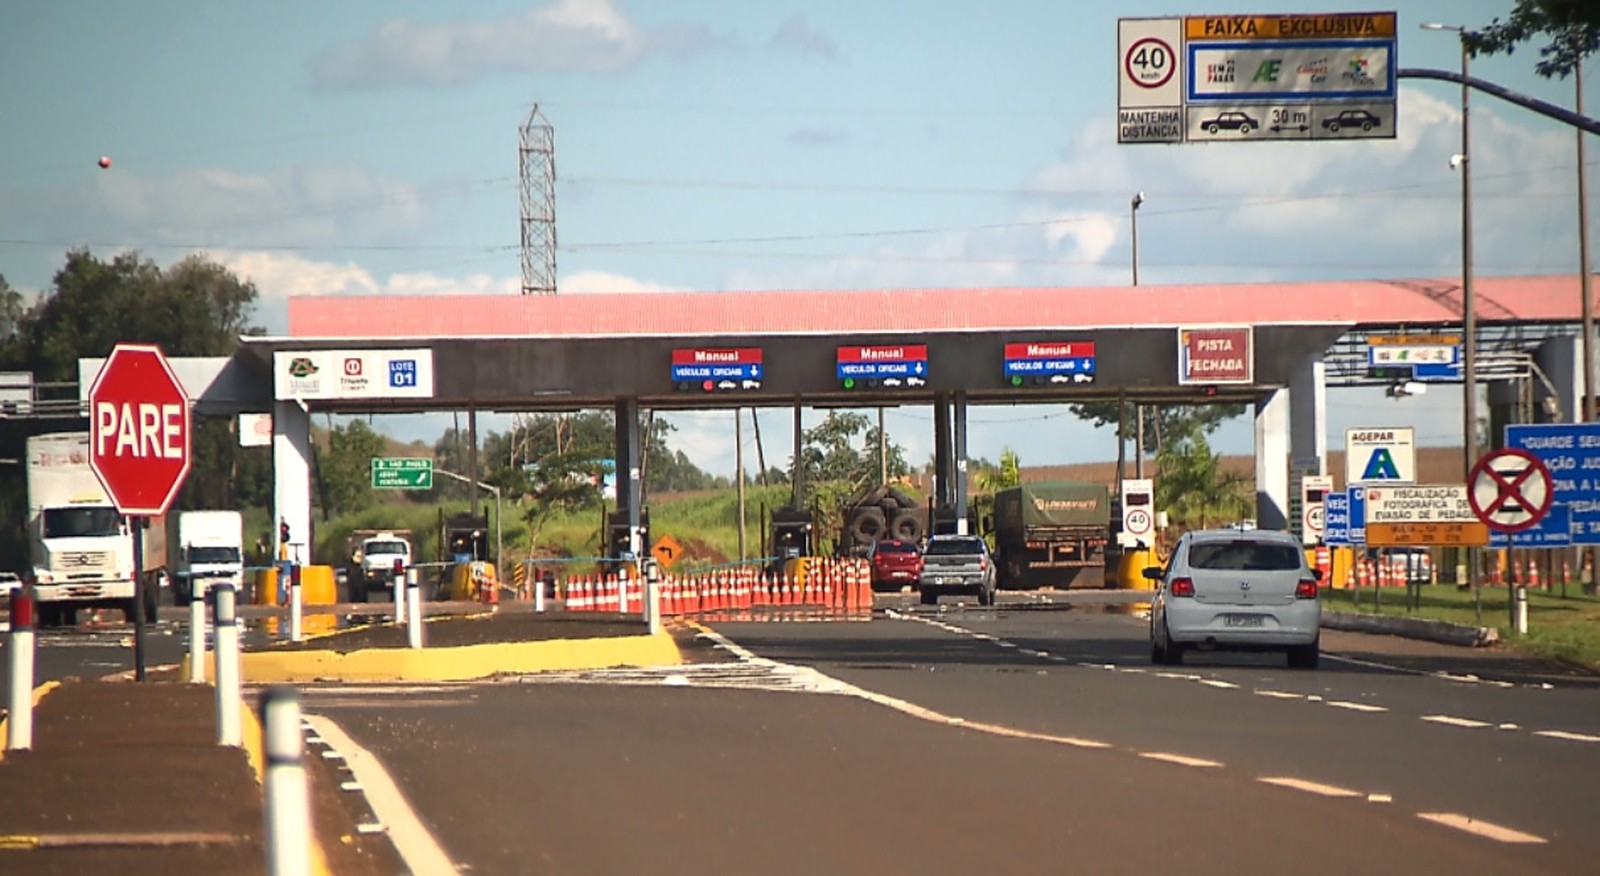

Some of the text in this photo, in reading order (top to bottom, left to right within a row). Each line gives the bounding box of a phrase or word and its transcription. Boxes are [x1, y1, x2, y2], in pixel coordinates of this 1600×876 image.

[1204, 17, 1375, 35] FAIXA EXCLUSIVA
[1132, 47, 1166, 69] 40
[1120, 111, 1180, 124] MANTENHA
[1271, 109, 1307, 124] 30 m
[1027, 344, 1072, 356] Manual
[1198, 339, 1233, 351] PISTA
[694, 350, 739, 361] Manual
[861, 347, 904, 359] Manual
[390, 361, 414, 371] LOTE
[1190, 359, 1244, 371] FECHADA
[394, 372, 413, 384] 01
[97, 402, 183, 459] PARE
[1351, 431, 1394, 441] AGEPAR
[1393, 488, 1460, 499] FISCALIZAÇÃO
[1327, 498, 1347, 509] VEÍC
[1131, 515, 1146, 524] 40
